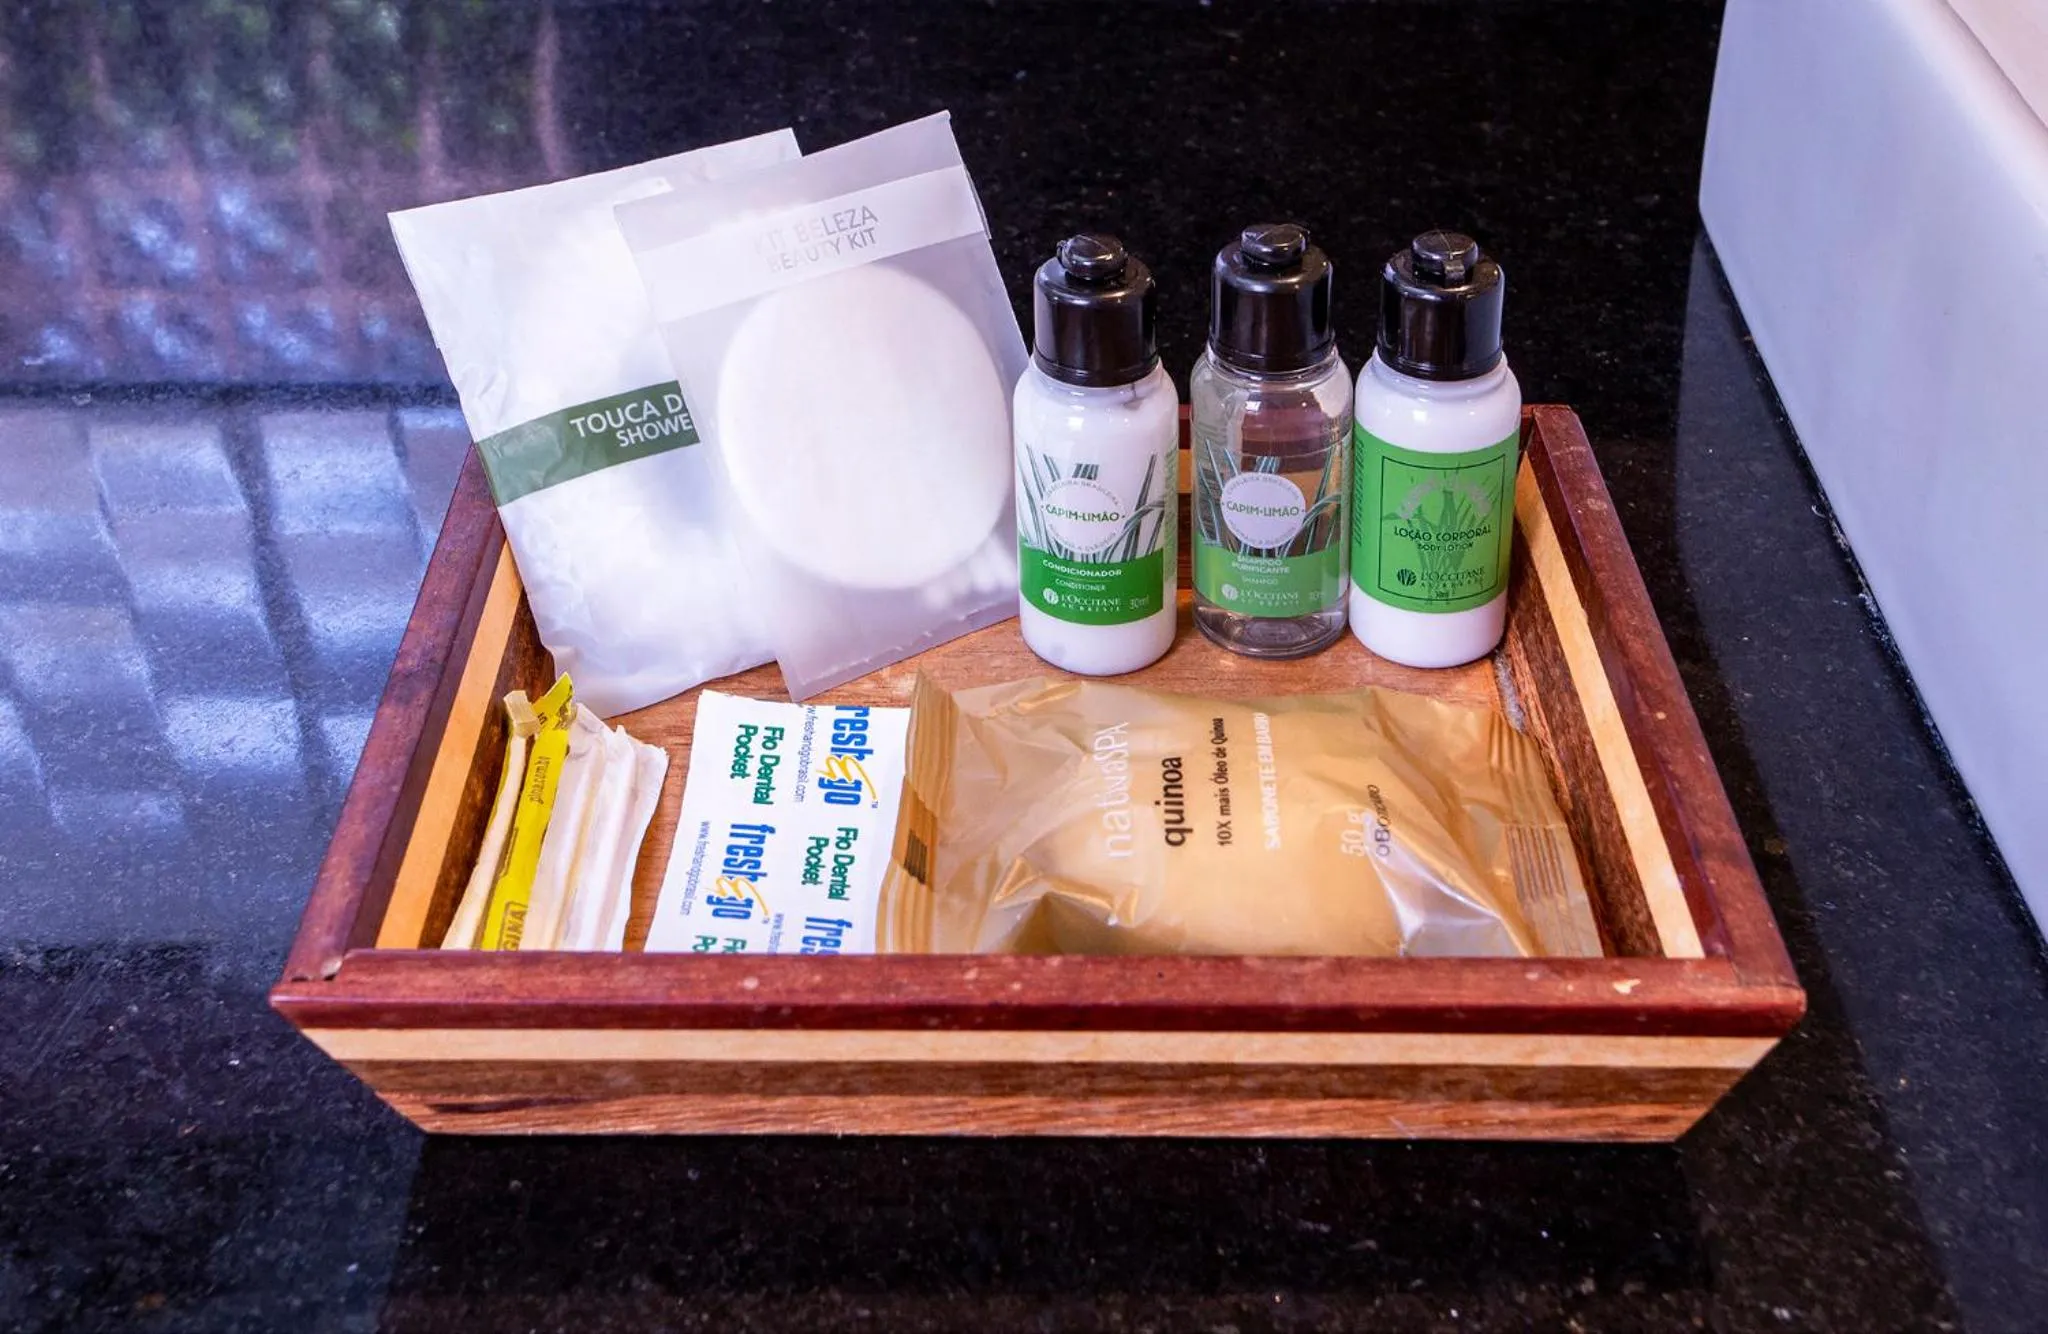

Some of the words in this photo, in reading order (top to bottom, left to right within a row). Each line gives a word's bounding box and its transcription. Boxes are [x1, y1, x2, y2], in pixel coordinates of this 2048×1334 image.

[794, 205, 878, 244] BELEZA
[767, 237, 840, 274] BEAUTY
[847, 227, 877, 250] KIT
[569, 399, 662, 438] TOUCA
[616, 412, 693, 448] SHOWE
[1418, 543, 1441, 551] BODY
[1435, 524, 1491, 541] CORPORAL
[1042, 559, 1122, 577] CONDICIONADOR
[1055, 578, 1106, 592] CONDITIONER
[760, 726, 785, 750] Fio
[1209, 718, 1228, 745] Quinoa
[730, 724, 759, 779] Pocket
[1212, 747, 1227, 758] de
[753, 754, 781, 805] Dental
[1209, 760, 1229, 785] Óleo
[1155, 757, 1194, 847] quinoa
[1214, 786, 1231, 816] mais
[1258, 762, 1282, 849] SABONETE
[834, 827, 859, 850] Fio
[1217, 821, 1233, 846] 10X
[1340, 829, 1366, 857] 50
[801, 836, 829, 886] Pocket
[827, 854, 856, 901] Dental
